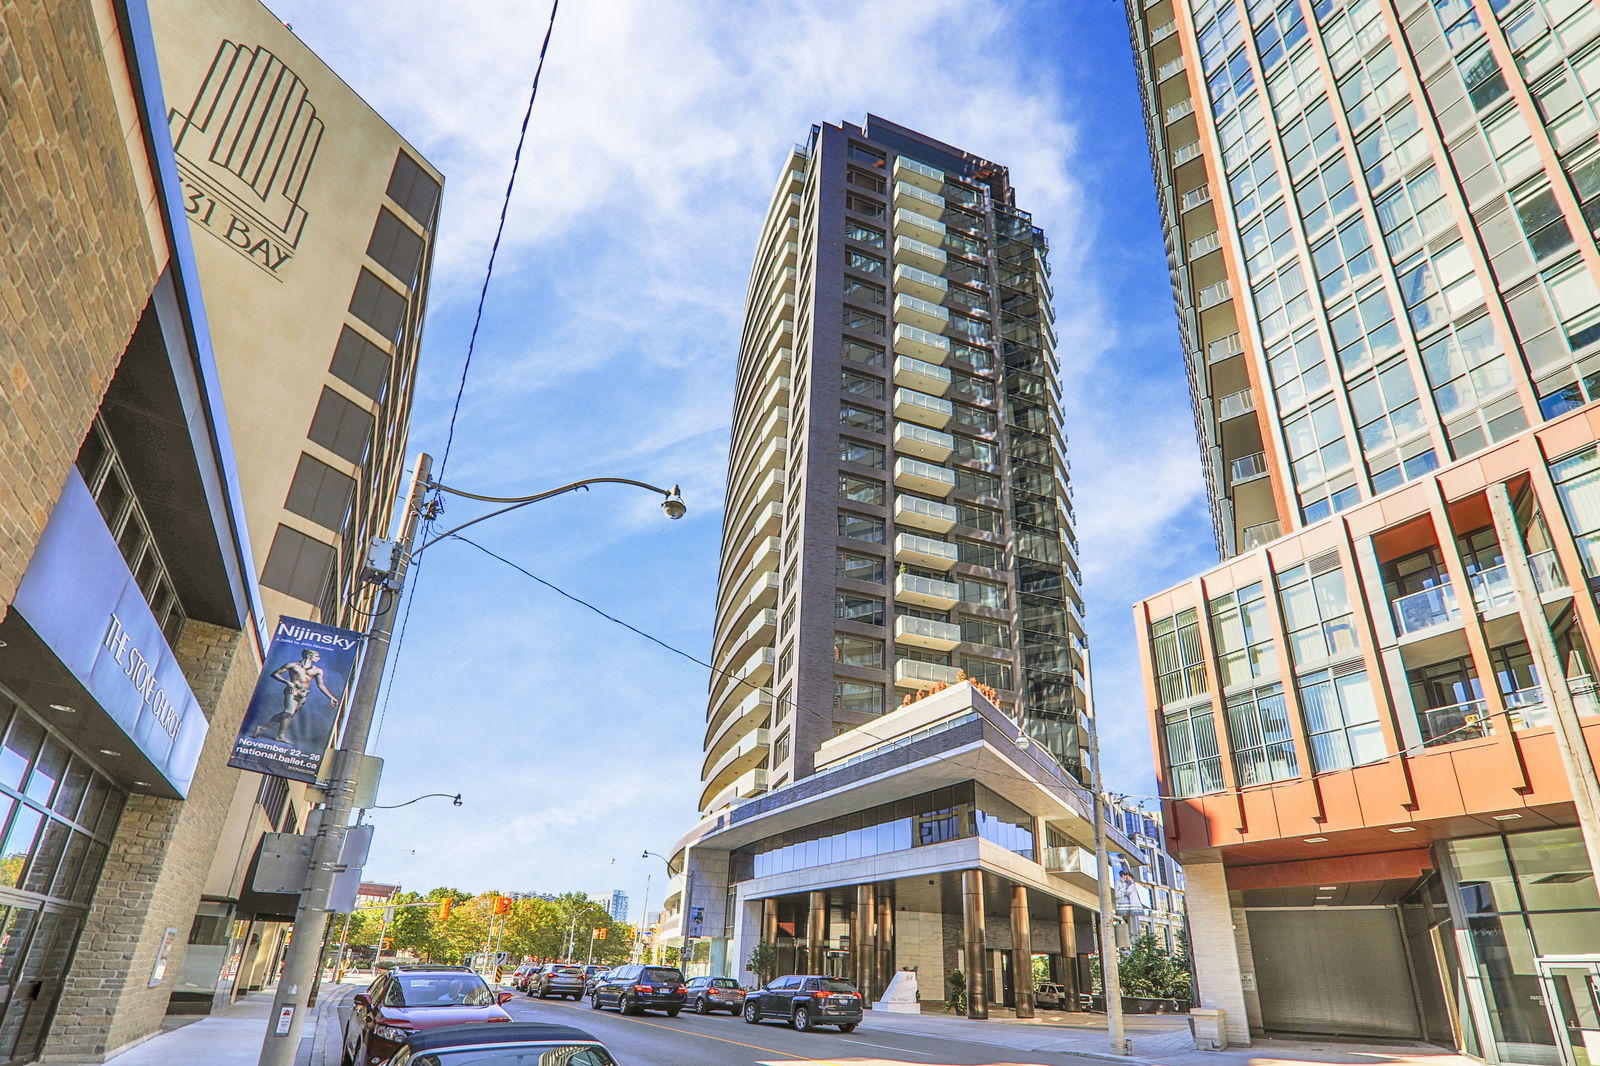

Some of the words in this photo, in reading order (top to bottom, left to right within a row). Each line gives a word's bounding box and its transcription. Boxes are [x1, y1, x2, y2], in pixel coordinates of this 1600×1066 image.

[223, 213, 293, 274] BAY
[277, 623, 356, 651] Nijinsky
[103, 612, 131, 666] THE
[123, 647, 158, 705] STONE
[152, 689, 183, 743] CHURCH
[235, 746, 317, 769] national.ballet.ca
[238, 738, 289, 754] November
